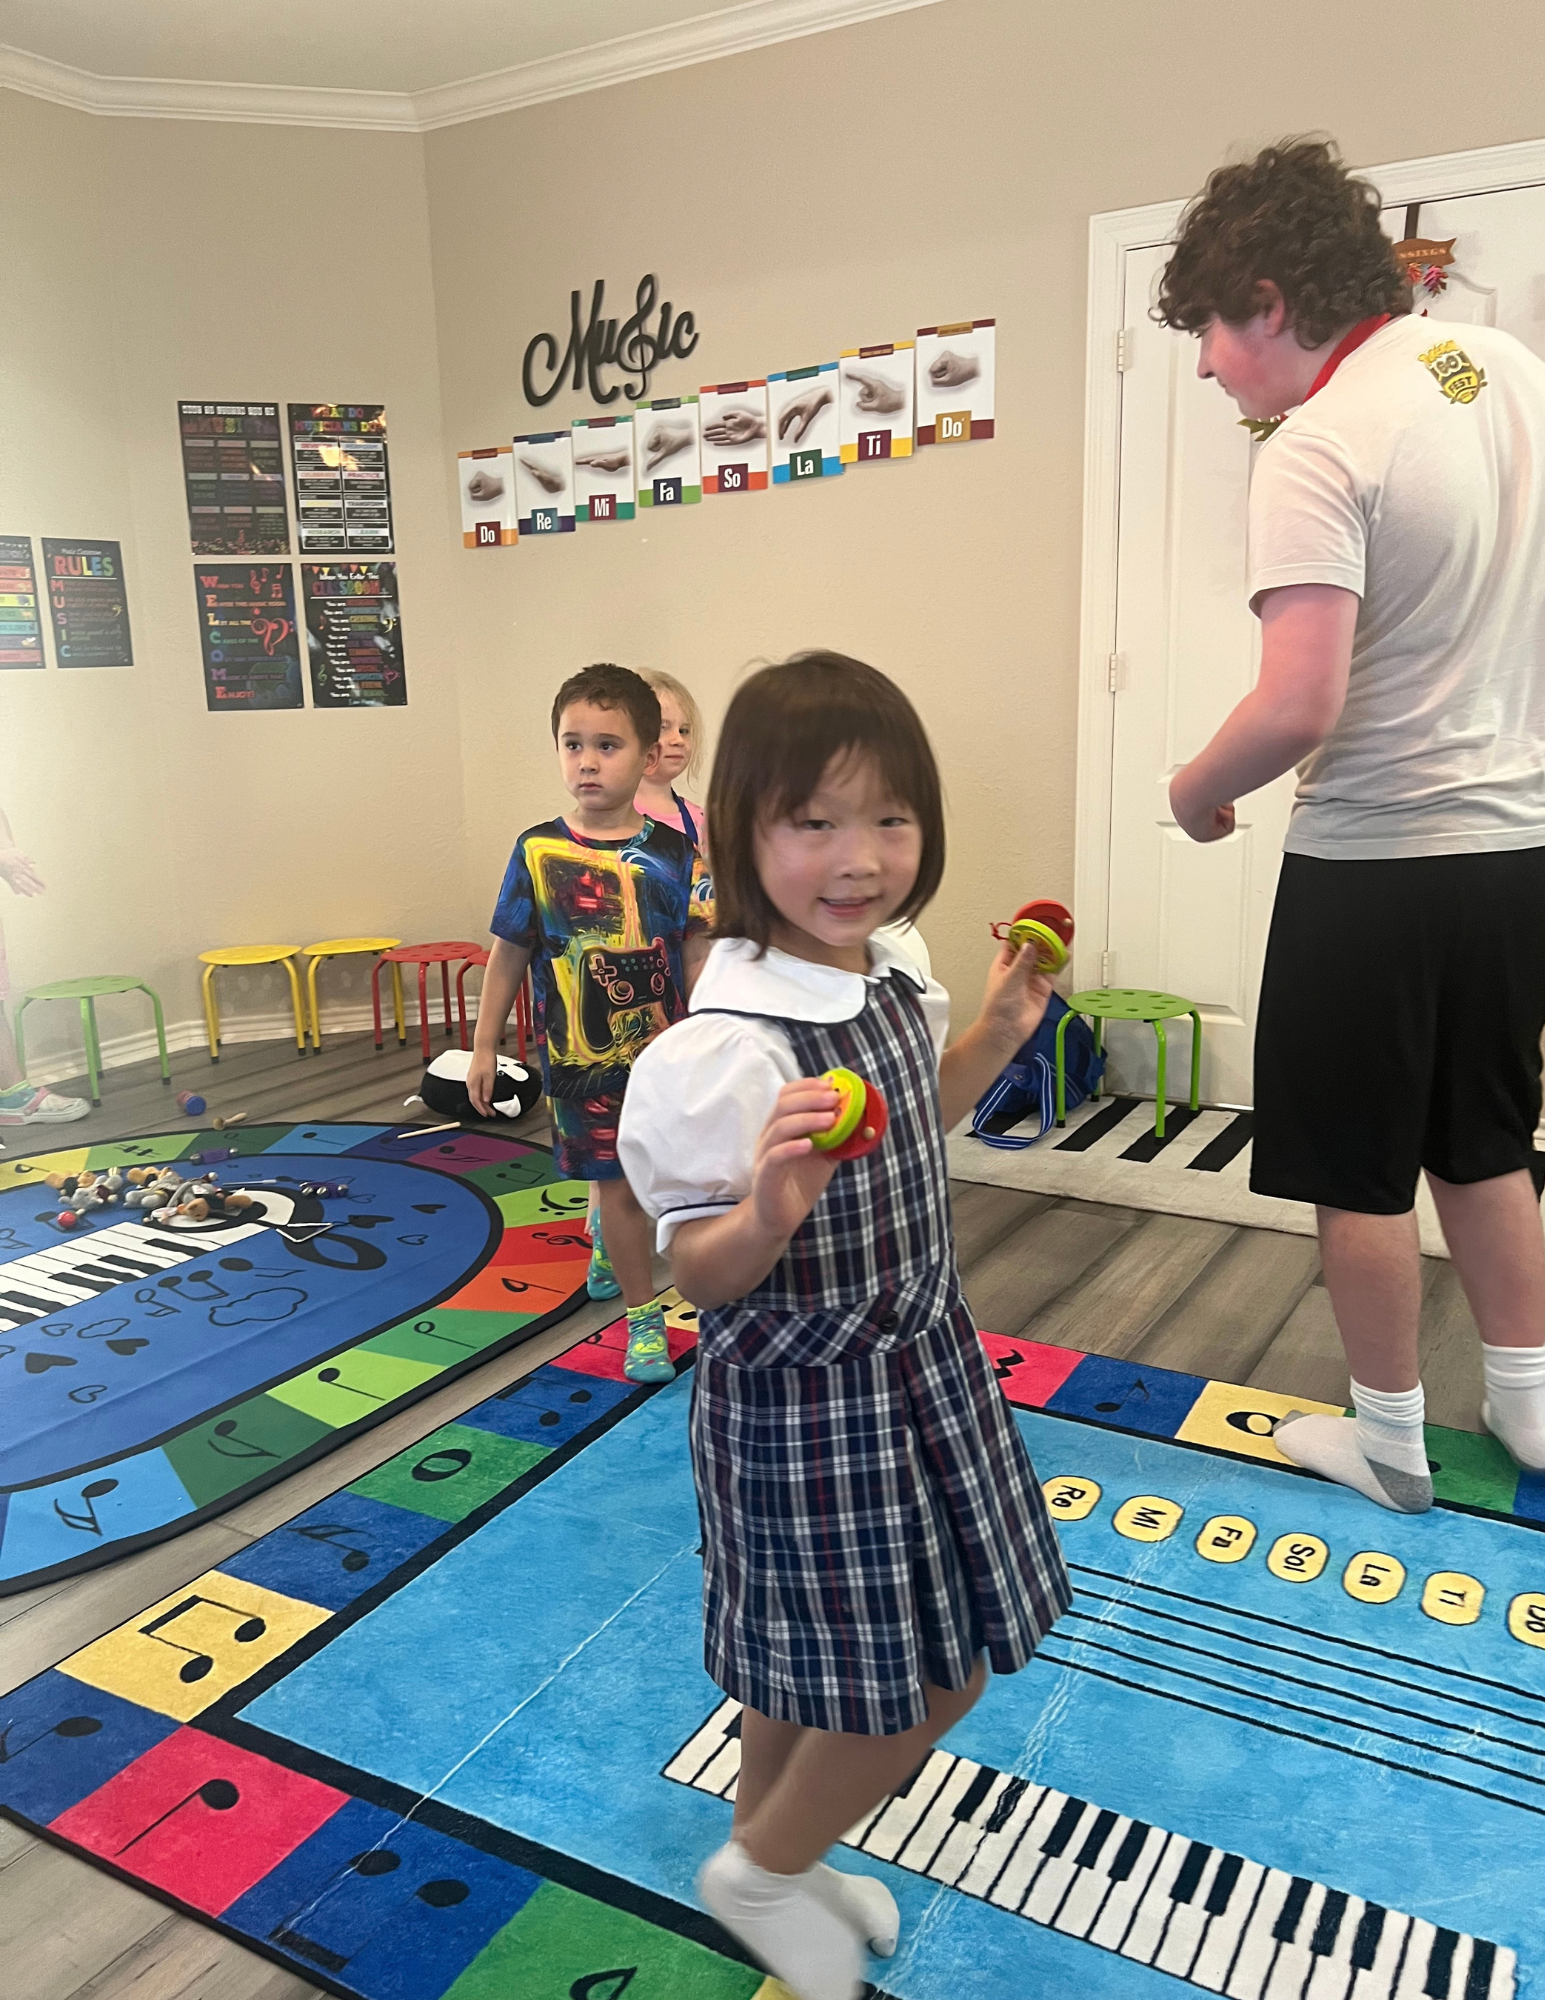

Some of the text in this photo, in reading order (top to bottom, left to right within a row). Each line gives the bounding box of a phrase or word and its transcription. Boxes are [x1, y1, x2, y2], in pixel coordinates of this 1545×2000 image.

[1399, 248, 1447, 258] SSINGS
[522, 273, 699, 407] Music
[866, 435, 881, 456] Ti
[796, 456, 814, 476] La
[724, 468, 741, 488] So
[659, 482, 675, 501] Fa
[594, 498, 610, 517] Mi
[536, 513, 552, 530] Re
[480, 525, 496, 543] Do
[54, 555, 114, 576] RULES
[1211, 1526, 1243, 1548] Fa
[1283, 1543, 1316, 1573] Sol
[1359, 1564, 1391, 1586] La
